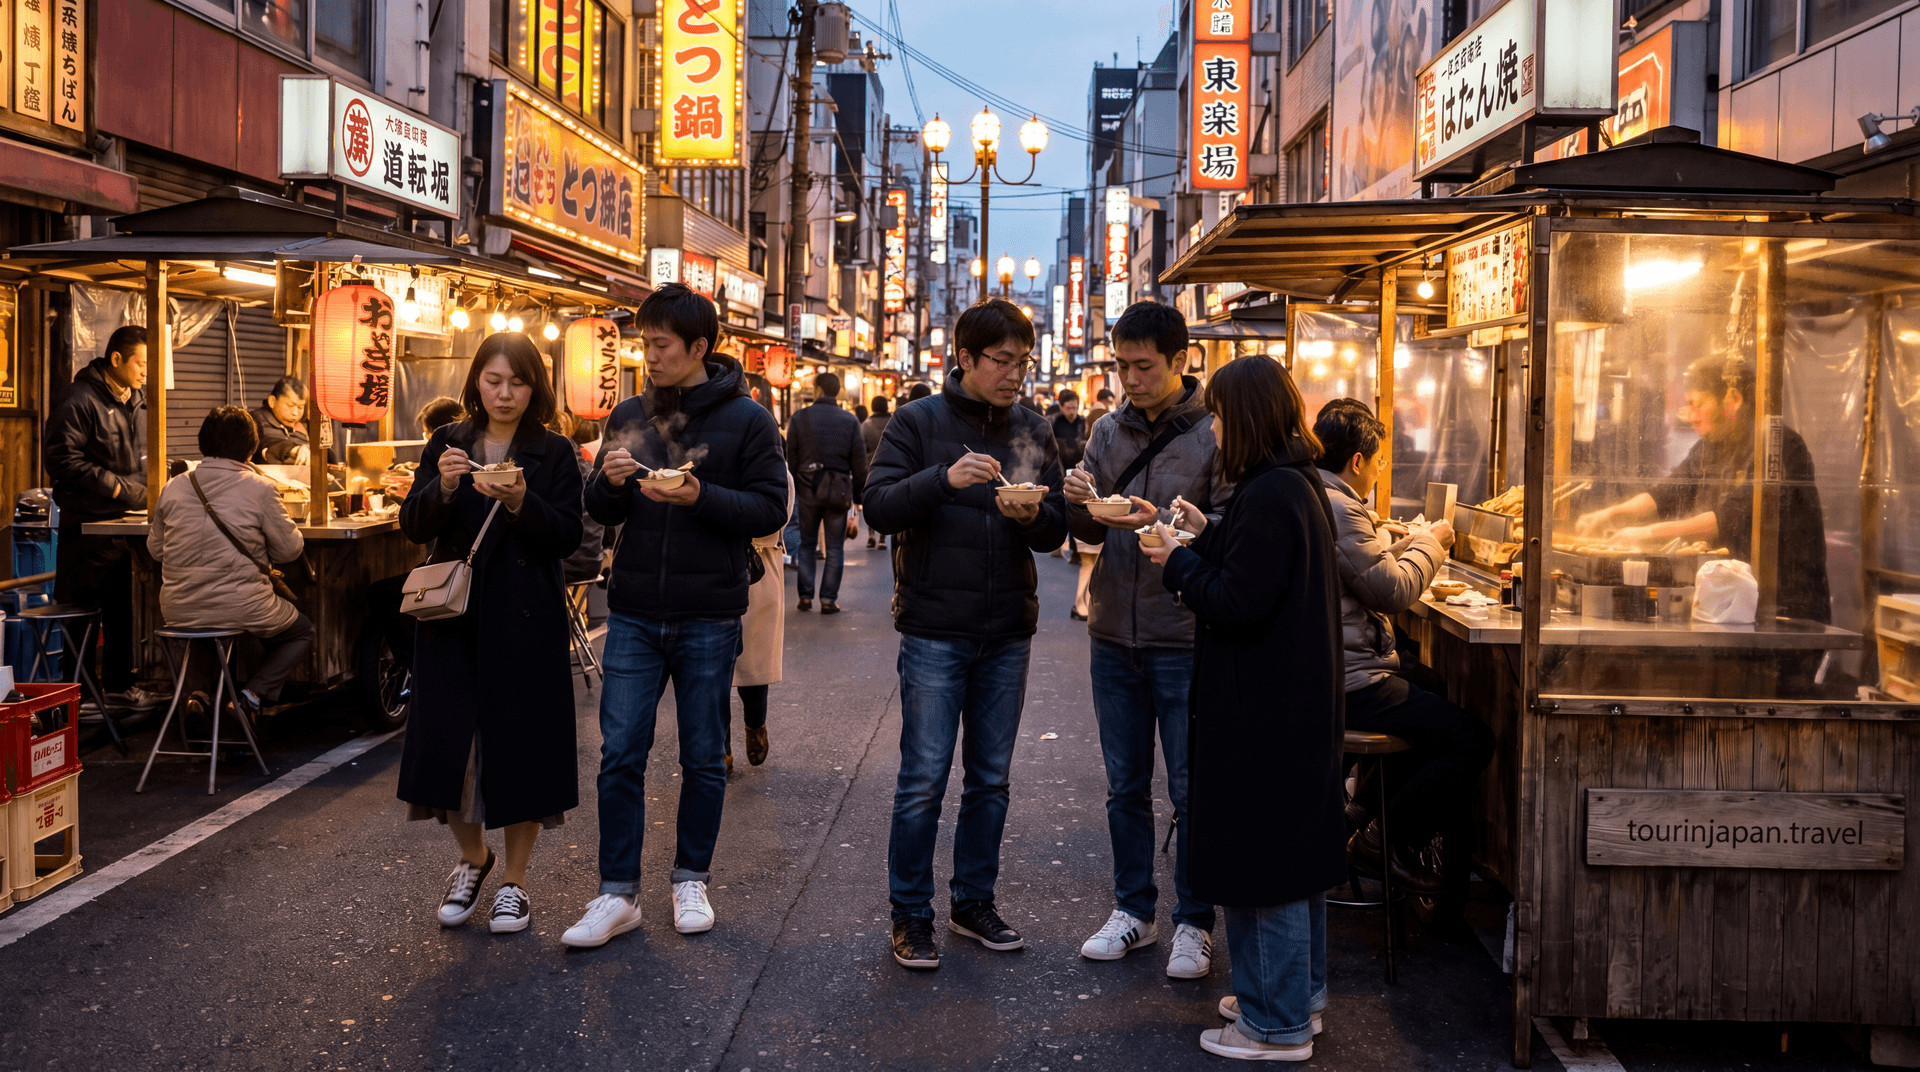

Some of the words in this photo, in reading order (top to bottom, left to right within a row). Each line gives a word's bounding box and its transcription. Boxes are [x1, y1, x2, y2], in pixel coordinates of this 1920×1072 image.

[1202, 58, 1239, 179] 東楽場
[1441, 38, 1519, 145] はたん焼
[382, 139, 450, 205] 道転堀
[1627, 818, 1863, 849] tourinjapan.travel
